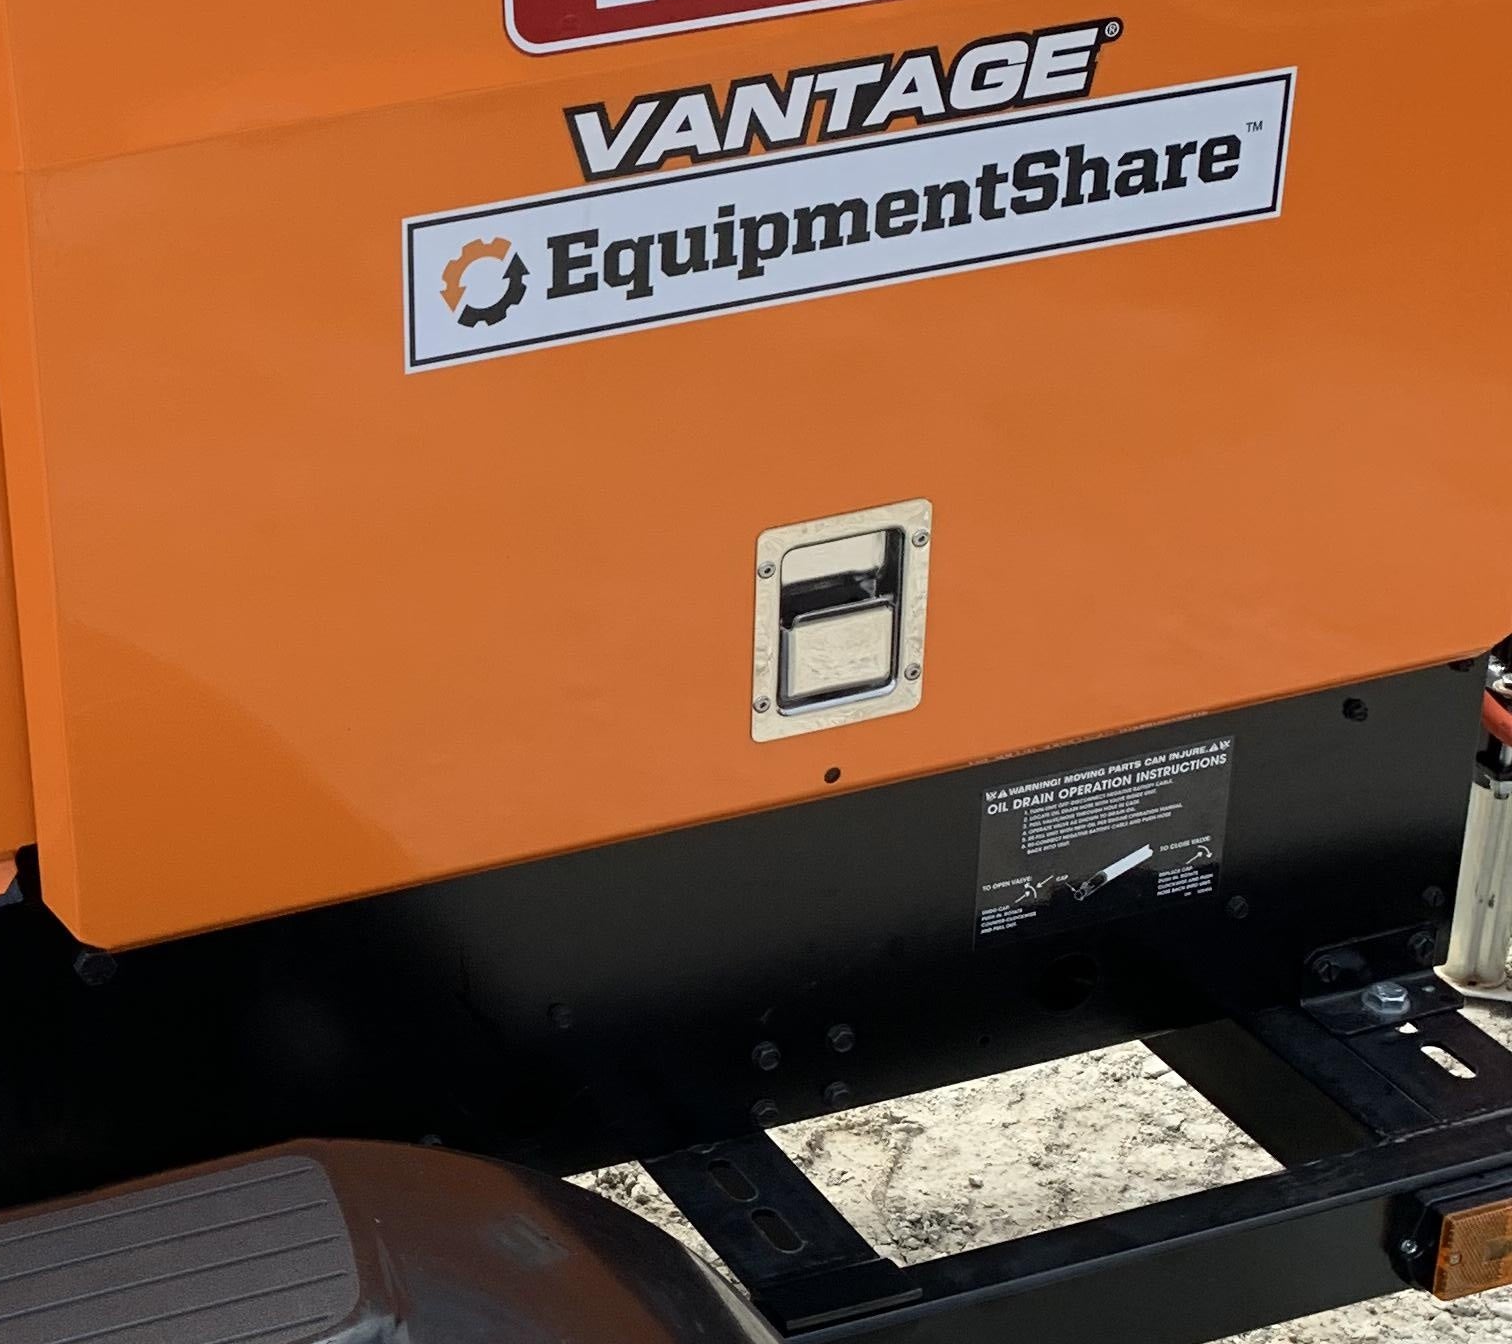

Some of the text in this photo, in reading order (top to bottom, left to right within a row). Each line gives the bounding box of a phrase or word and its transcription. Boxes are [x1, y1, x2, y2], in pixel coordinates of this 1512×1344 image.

[987, 753, 1227, 815] OIL DRAIN OPERATION INSTRUCTIONS
[1008, 745, 1209, 796] WARNING! MOVING PARTS CAN INJURE.
